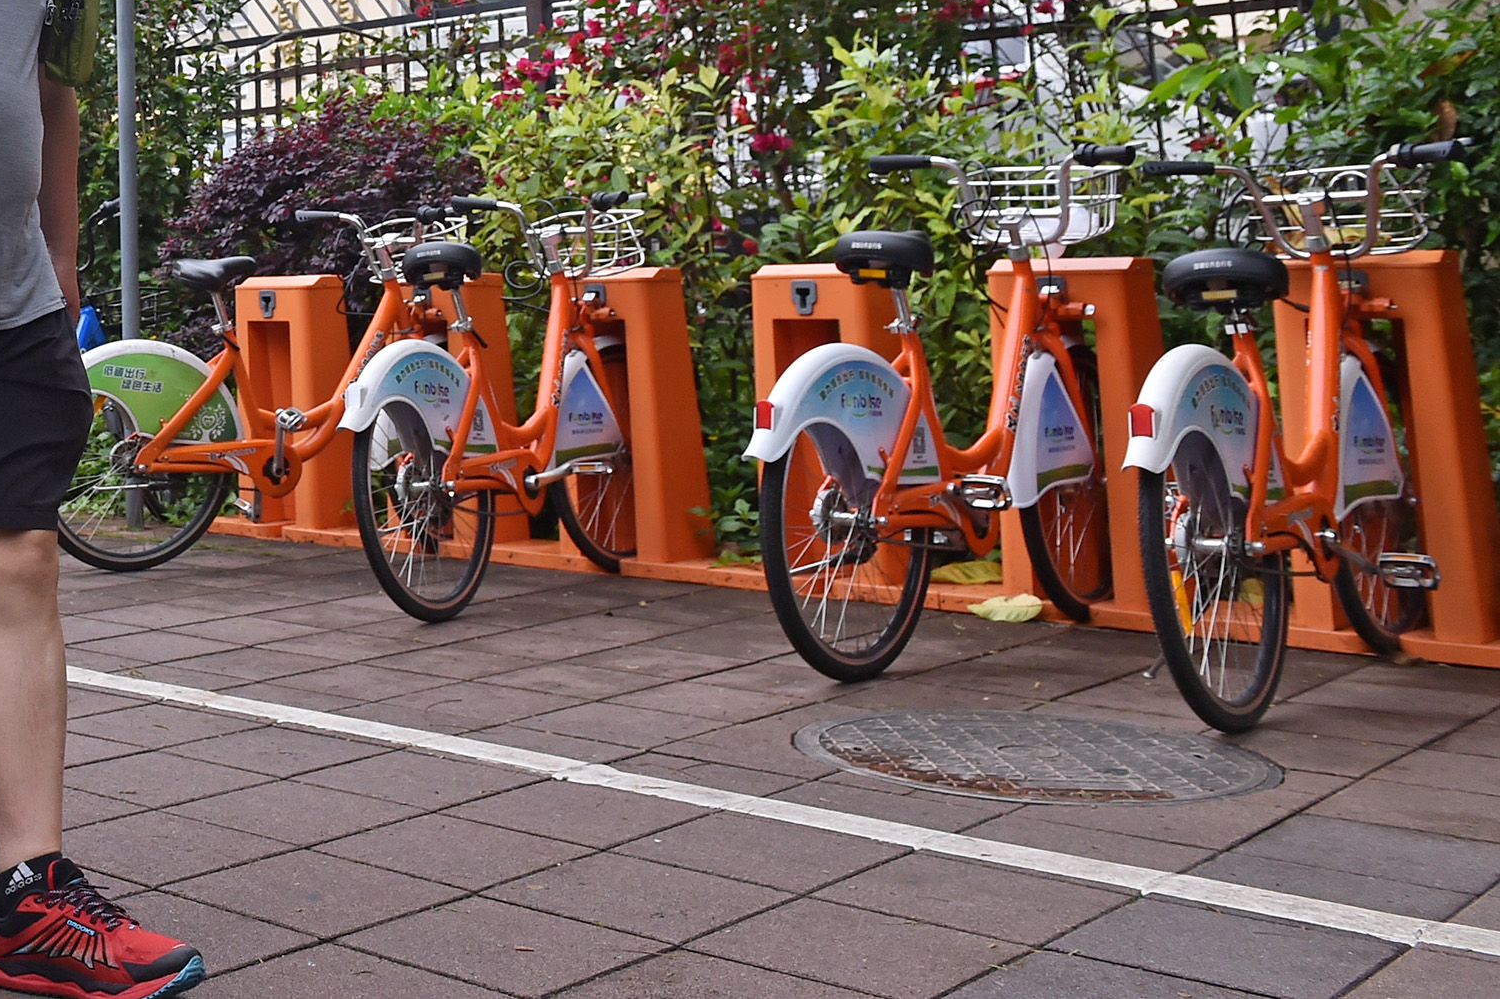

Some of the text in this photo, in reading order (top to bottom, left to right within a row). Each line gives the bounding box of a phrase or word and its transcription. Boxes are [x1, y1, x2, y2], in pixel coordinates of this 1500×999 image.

[121, 379, 163, 394] 绿色生活
[4, 872, 43, 896] adidas
[66, 919, 96, 936] BROOKS
